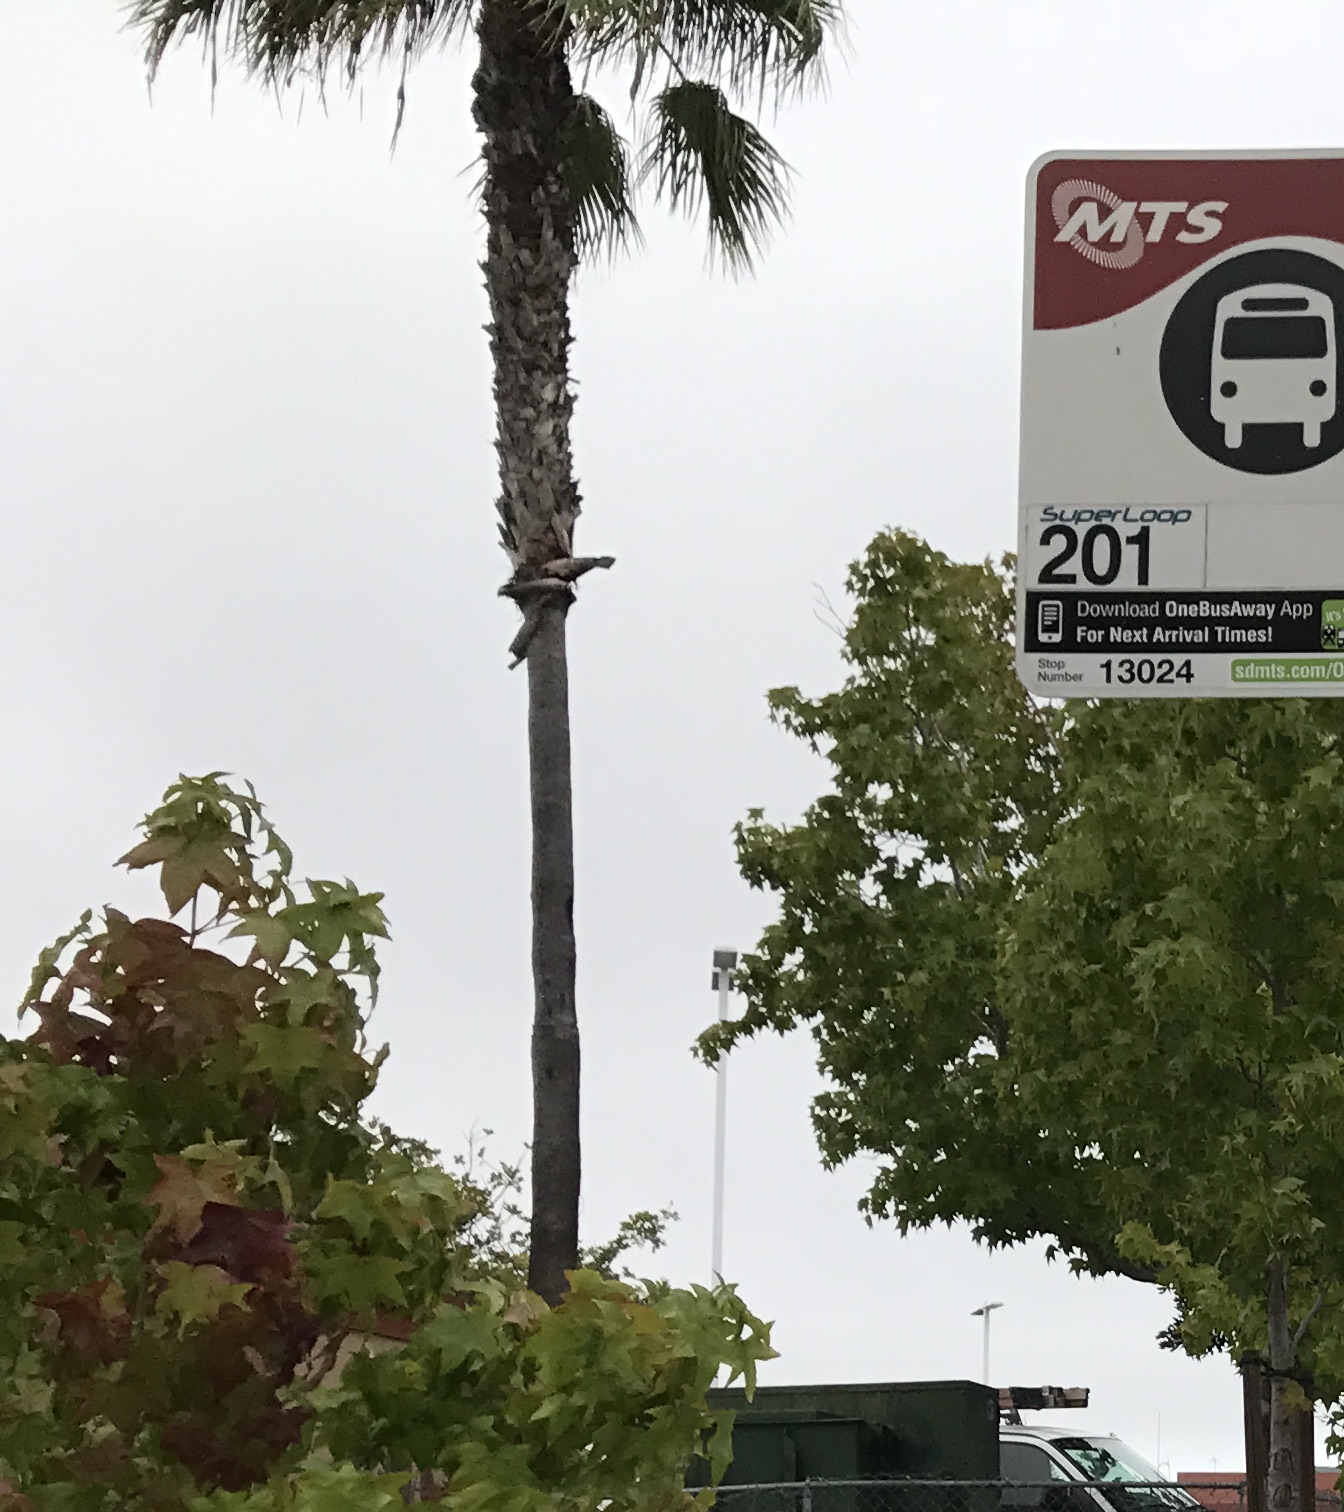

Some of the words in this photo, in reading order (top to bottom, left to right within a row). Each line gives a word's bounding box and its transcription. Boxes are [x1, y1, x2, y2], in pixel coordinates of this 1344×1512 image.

[1053, 201, 1229, 243] MTS
[1038, 523, 1150, 586] 201
[1077, 600, 1160, 618] Download
[1165, 600, 1276, 620] OneBusAway
[1280, 600, 1314, 620] App
[1076, 626, 1105, 643] For
[1109, 626, 1149, 643] Next
[1152, 626, 1209, 643] Arrival
[1214, 626, 1273, 643] Times!
[1037, 657, 1066, 670] Stop
[1099, 658, 1195, 685] 13024
[1037, 671, 1085, 683] Number
